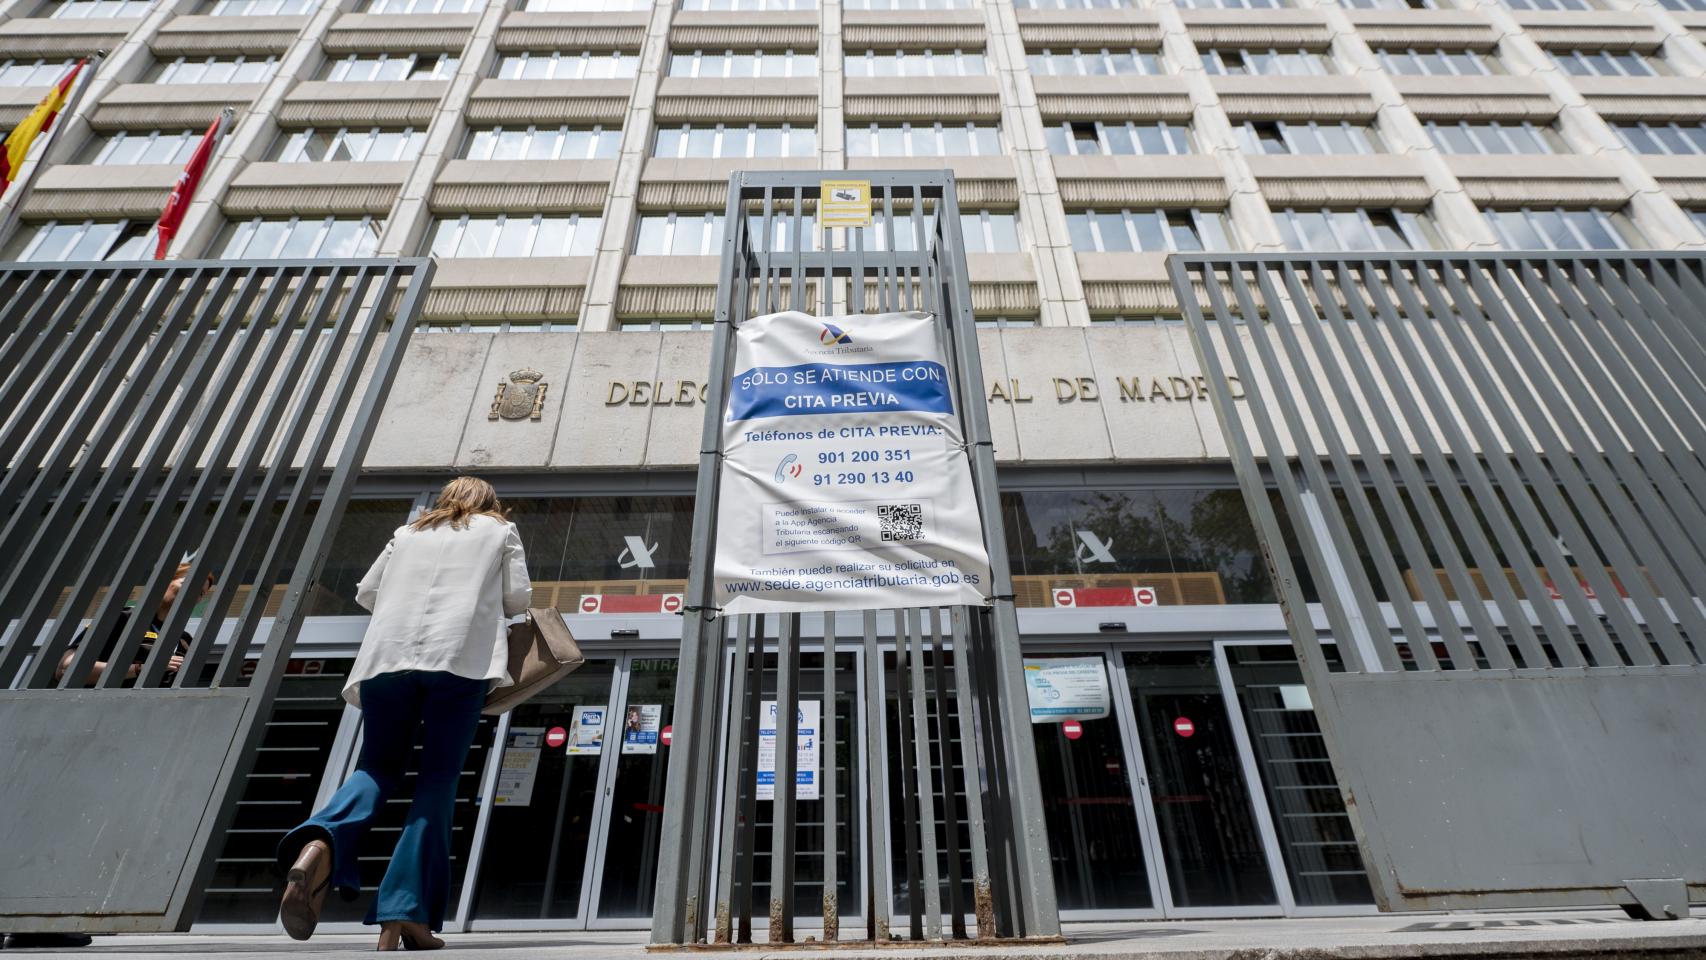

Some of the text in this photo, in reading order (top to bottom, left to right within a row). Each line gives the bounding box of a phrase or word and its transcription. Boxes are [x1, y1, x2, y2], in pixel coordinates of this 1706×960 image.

[794, 370, 817, 385] SE
[821, 368, 896, 384] ATIENDE
[901, 367, 940, 382] CON
[1053, 376, 1099, 404] DE
[1116, 376, 1246, 403] MADRD
[784, 391, 899, 409] CITA PREVIA
[744, 425, 943, 443] Teléfonos de CITA PREVIA:
[818, 450, 911, 464] 901 200 351
[813, 470, 914, 486] 91 290 13 40
[775, 509, 799, 517] Puede
[807, 516, 837, 526] Agencia
[775, 524, 859, 536] Tributaria escaneando
[775, 539, 783, 547] el
[784, 538, 819, 548] siguiente
[848, 534, 862, 544] QR
[750, 559, 955, 577] También puede realizar su solicitud en
[725, 571, 980, 593] www.sede.agenciatributaria.gob.es
